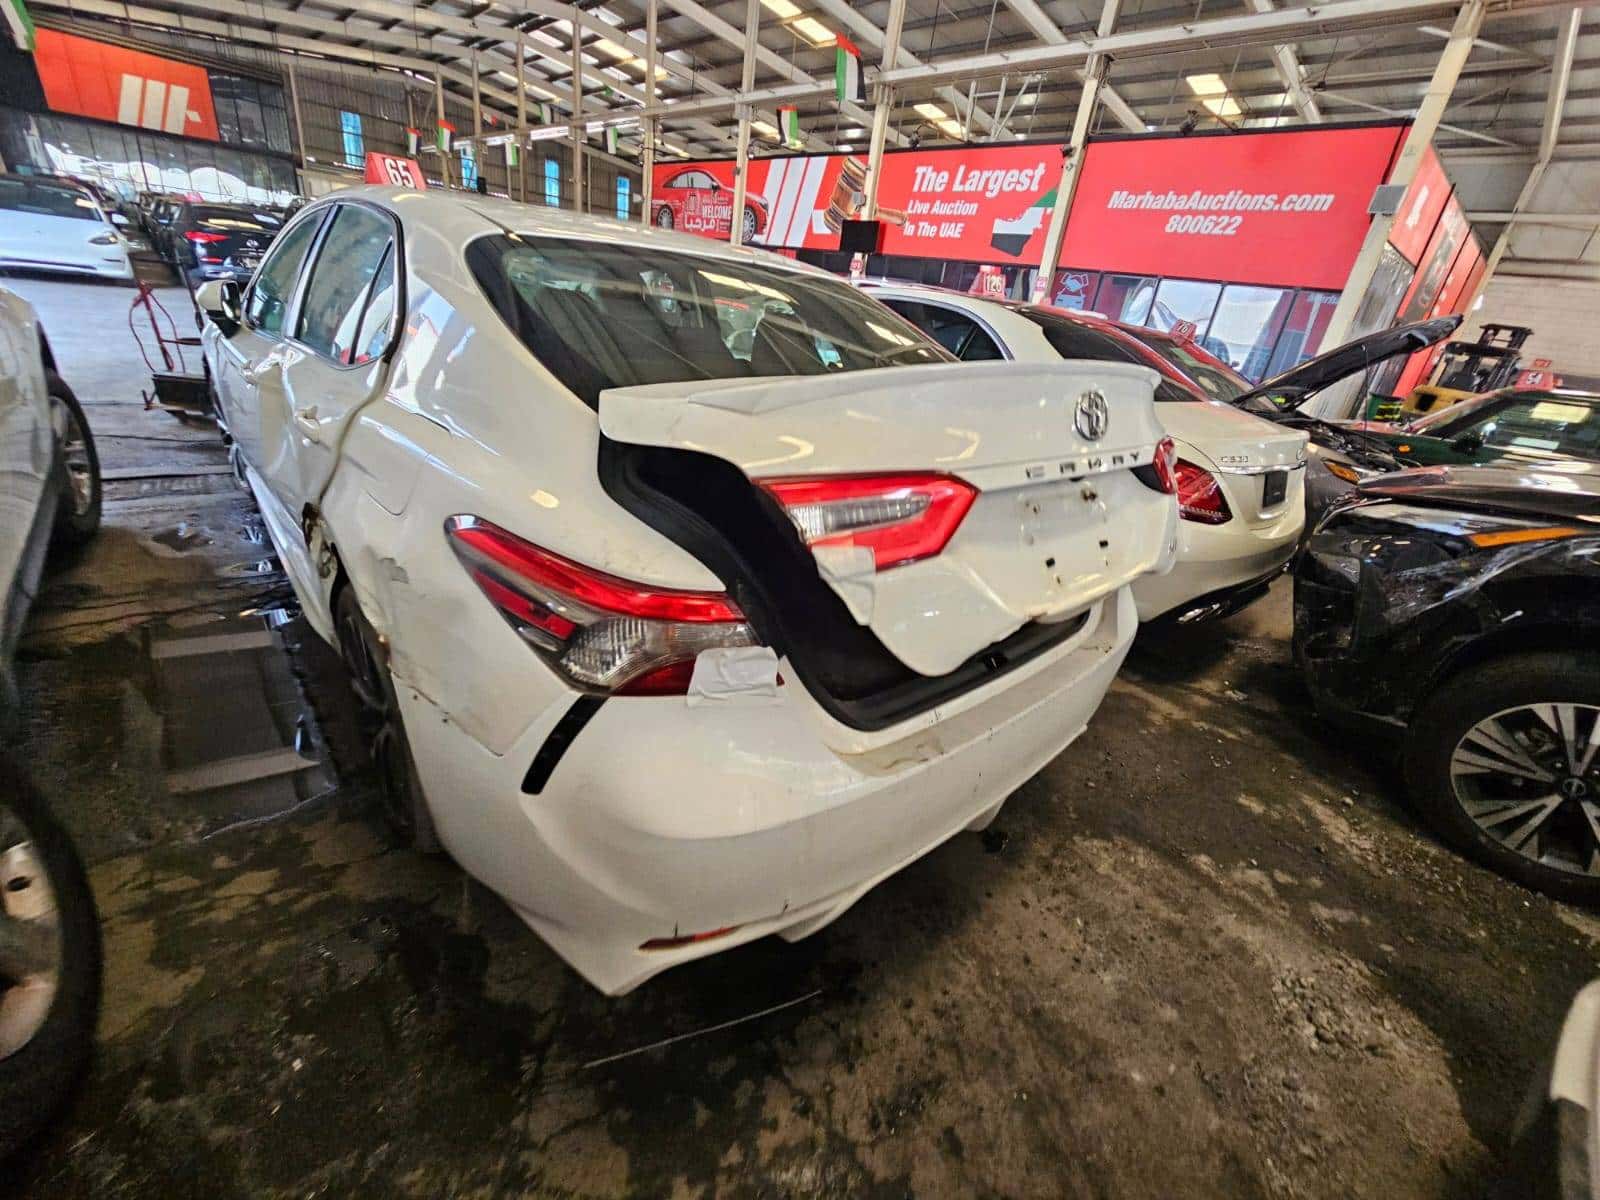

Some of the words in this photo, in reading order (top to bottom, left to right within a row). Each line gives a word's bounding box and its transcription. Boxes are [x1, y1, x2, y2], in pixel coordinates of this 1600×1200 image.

[384, 158, 415, 189] 65
[912, 165, 949, 193] The
[952, 161, 1046, 198] Largest
[702, 204, 732, 220] WELCOME
[907, 199, 931, 215] Live
[930, 201, 979, 216] Auction
[1107, 190, 1335, 212] MarhabaAuctions.com
[904, 222, 915, 237] In
[917, 221, 936, 237] The
[938, 223, 965, 238] UAE
[1165, 214, 1243, 236] 800622
